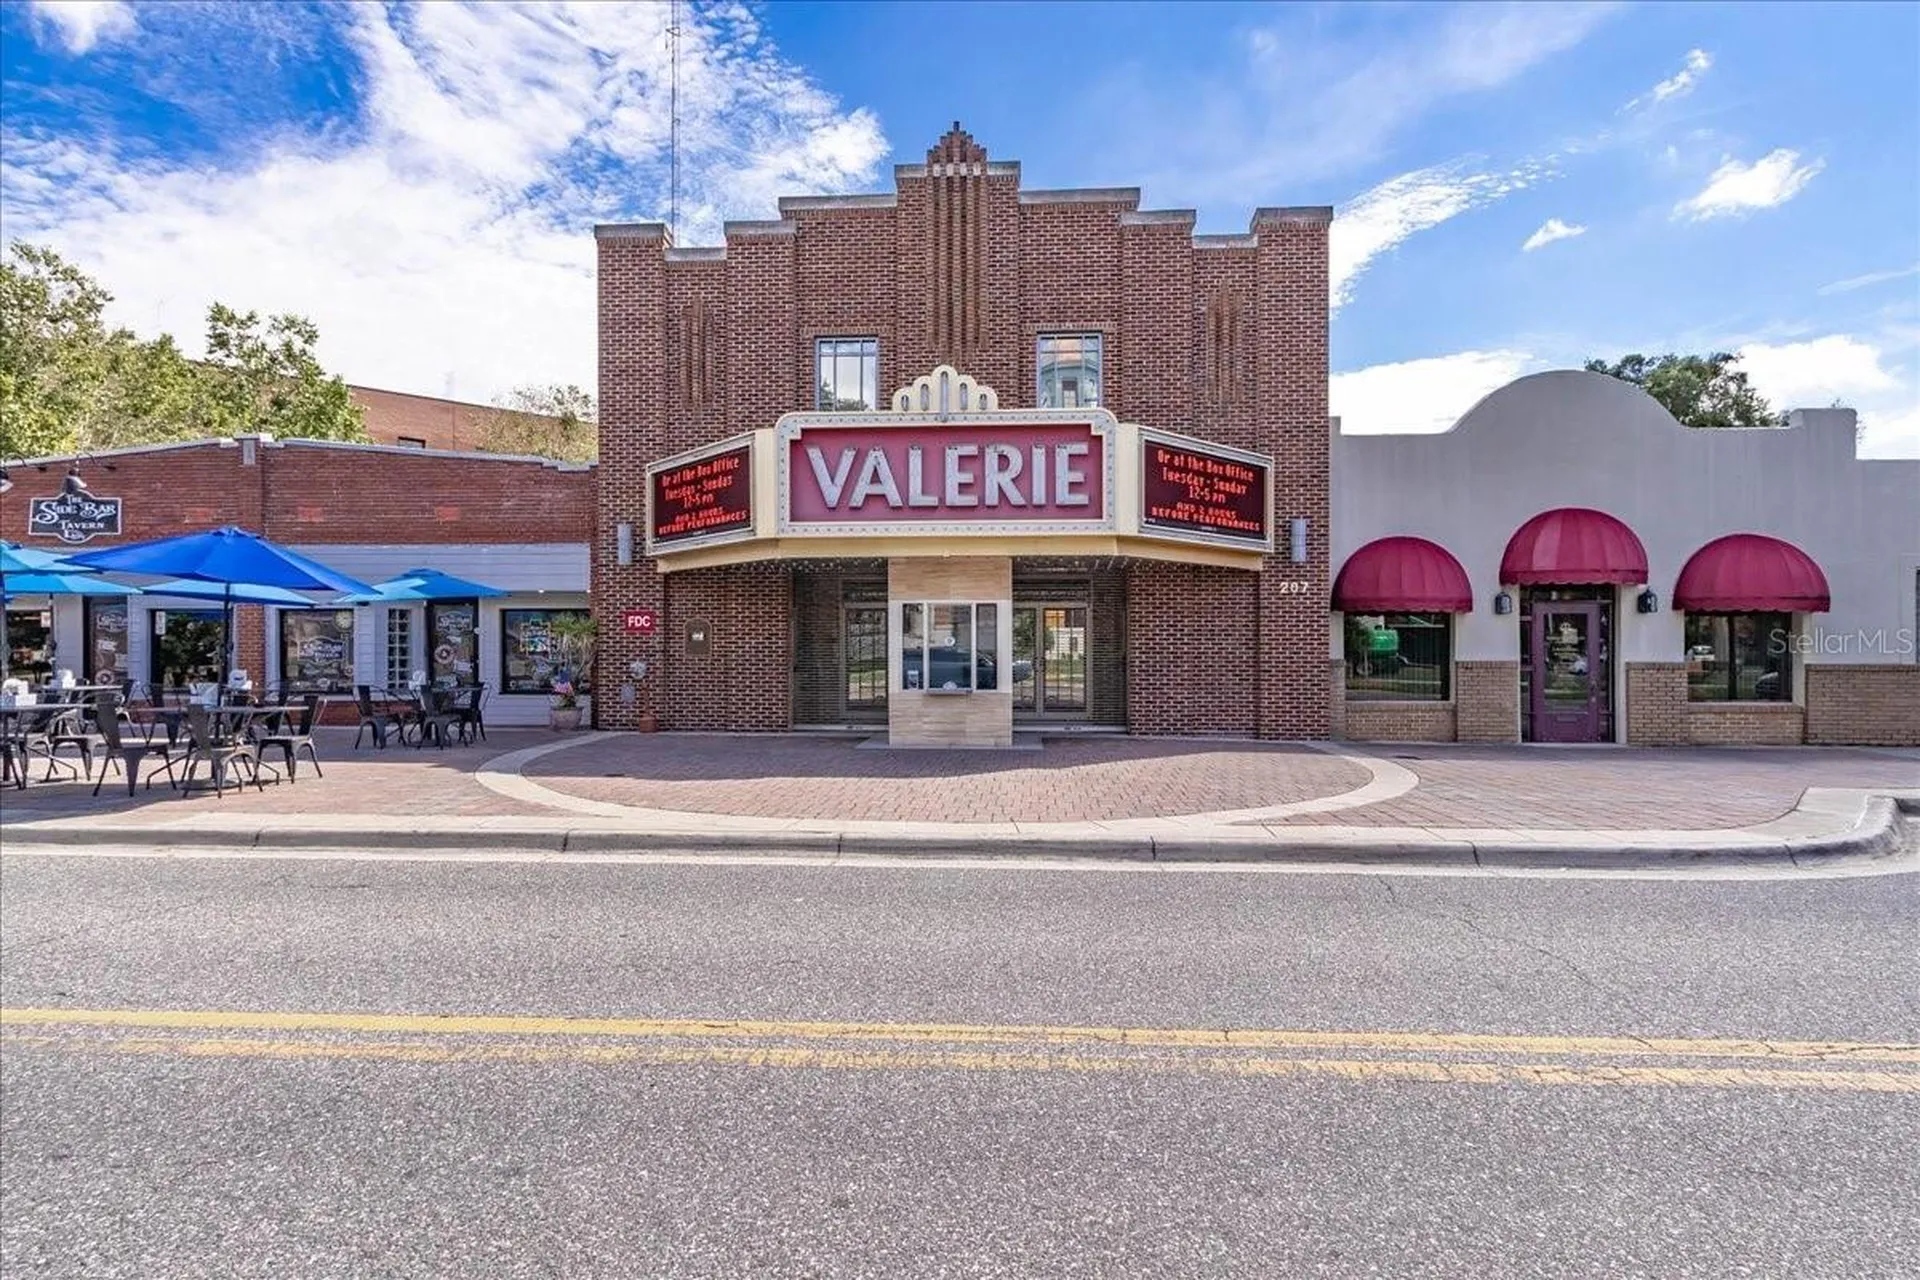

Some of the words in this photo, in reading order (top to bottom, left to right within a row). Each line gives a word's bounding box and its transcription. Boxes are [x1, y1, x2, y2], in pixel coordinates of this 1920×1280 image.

[683, 467, 696, 481] the
[697, 465, 712, 478] Box
[712, 457, 740, 473] Office
[1157, 449, 1171, 464] Or
[1173, 454, 1185, 467] at
[1187, 456, 1204, 472] the
[1207, 460, 1224, 475] Box
[1225, 464, 1255, 482] Office
[806, 444, 1090, 508] VALERIE
[1162, 467, 1204, 486] Tuesday
[1213, 477, 1248, 495] Sunday
[665, 484, 695, 501] Tuesday
[702, 475, 733, 492] Sunday
[1188, 486, 1210, 502] 12-5
[1212, 492, 1226, 503] pm
[683, 494, 702, 509] 12-5
[1151, 506, 1190, 521] BEFORE
[1280, 581, 1308, 593] 207
[628, 615, 650, 627] FDC
